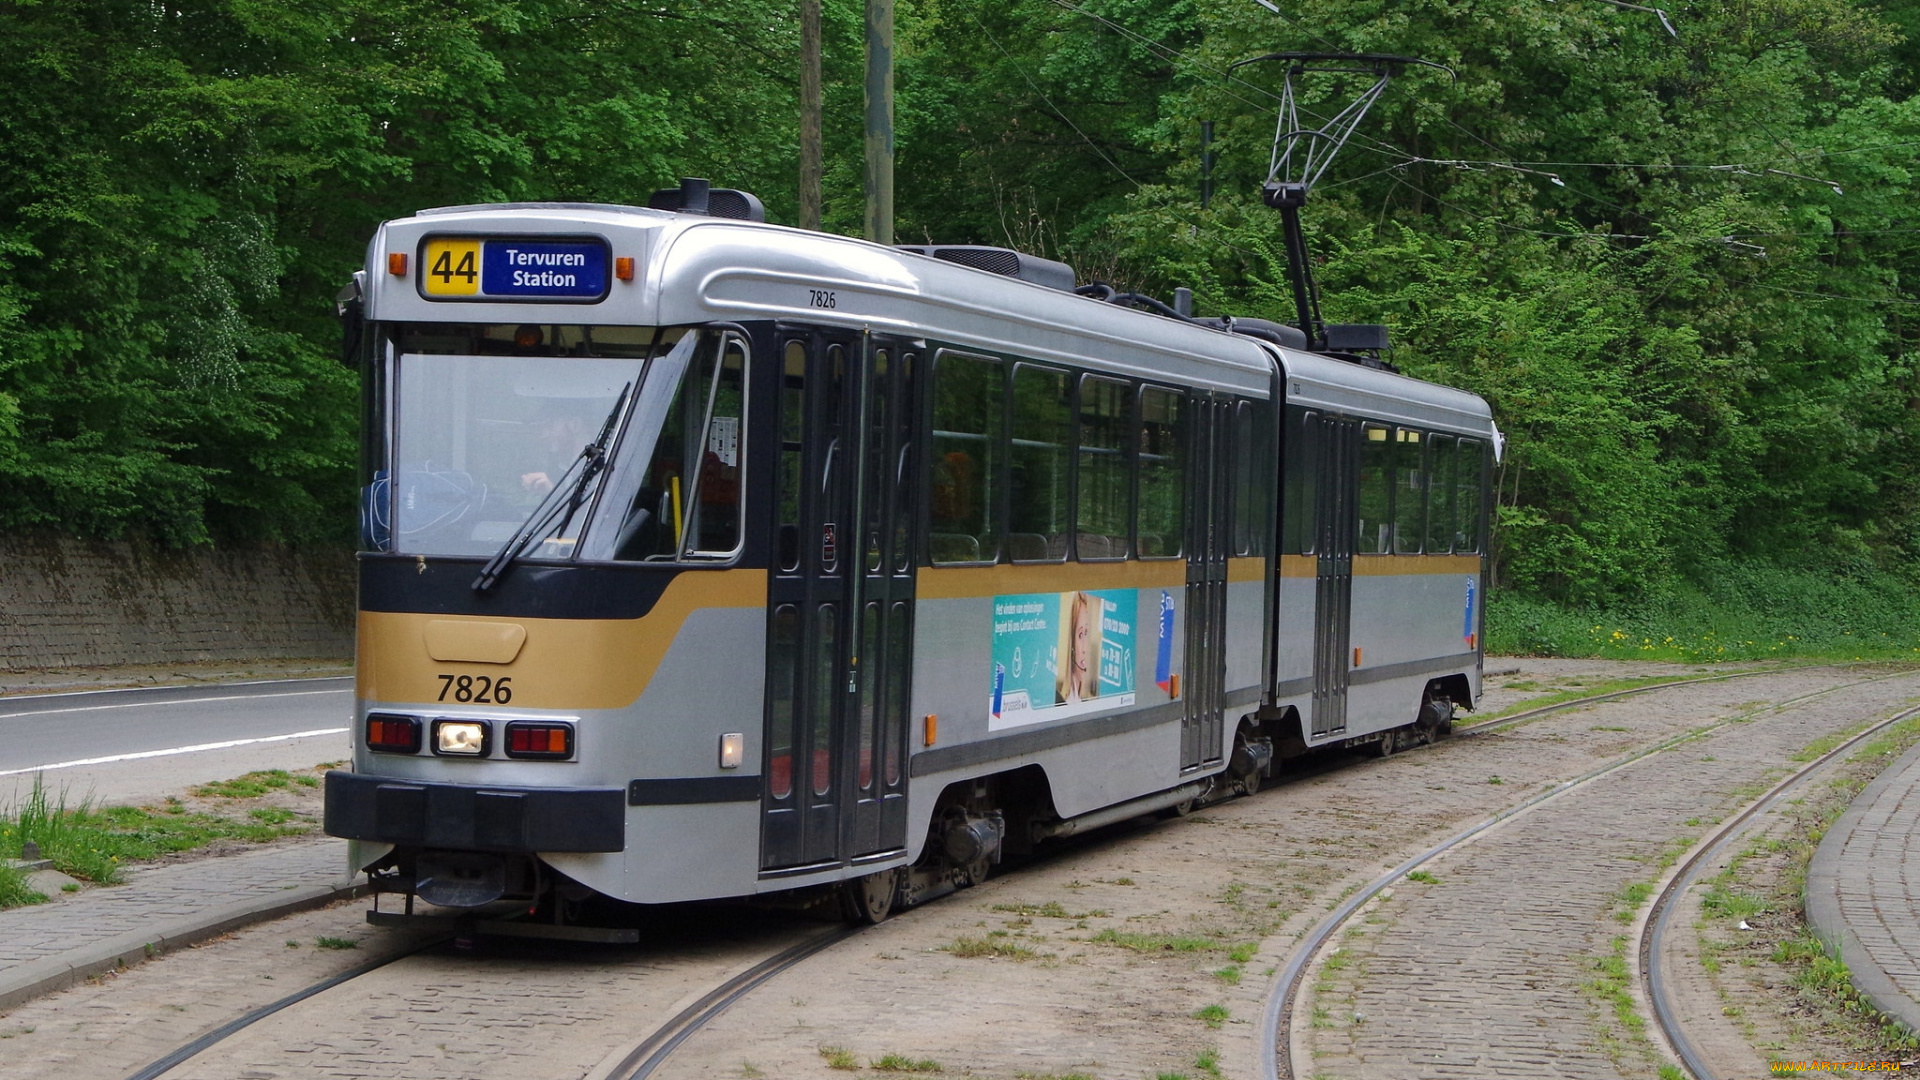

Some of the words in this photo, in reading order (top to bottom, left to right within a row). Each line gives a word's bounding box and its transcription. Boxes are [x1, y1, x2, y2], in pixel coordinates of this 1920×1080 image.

[431, 250, 477, 284] 44
[506, 249, 584, 266] Tervuren
[513, 270, 576, 287] Station
[809, 289, 836, 309] 7826
[437, 674, 512, 704] 7826
